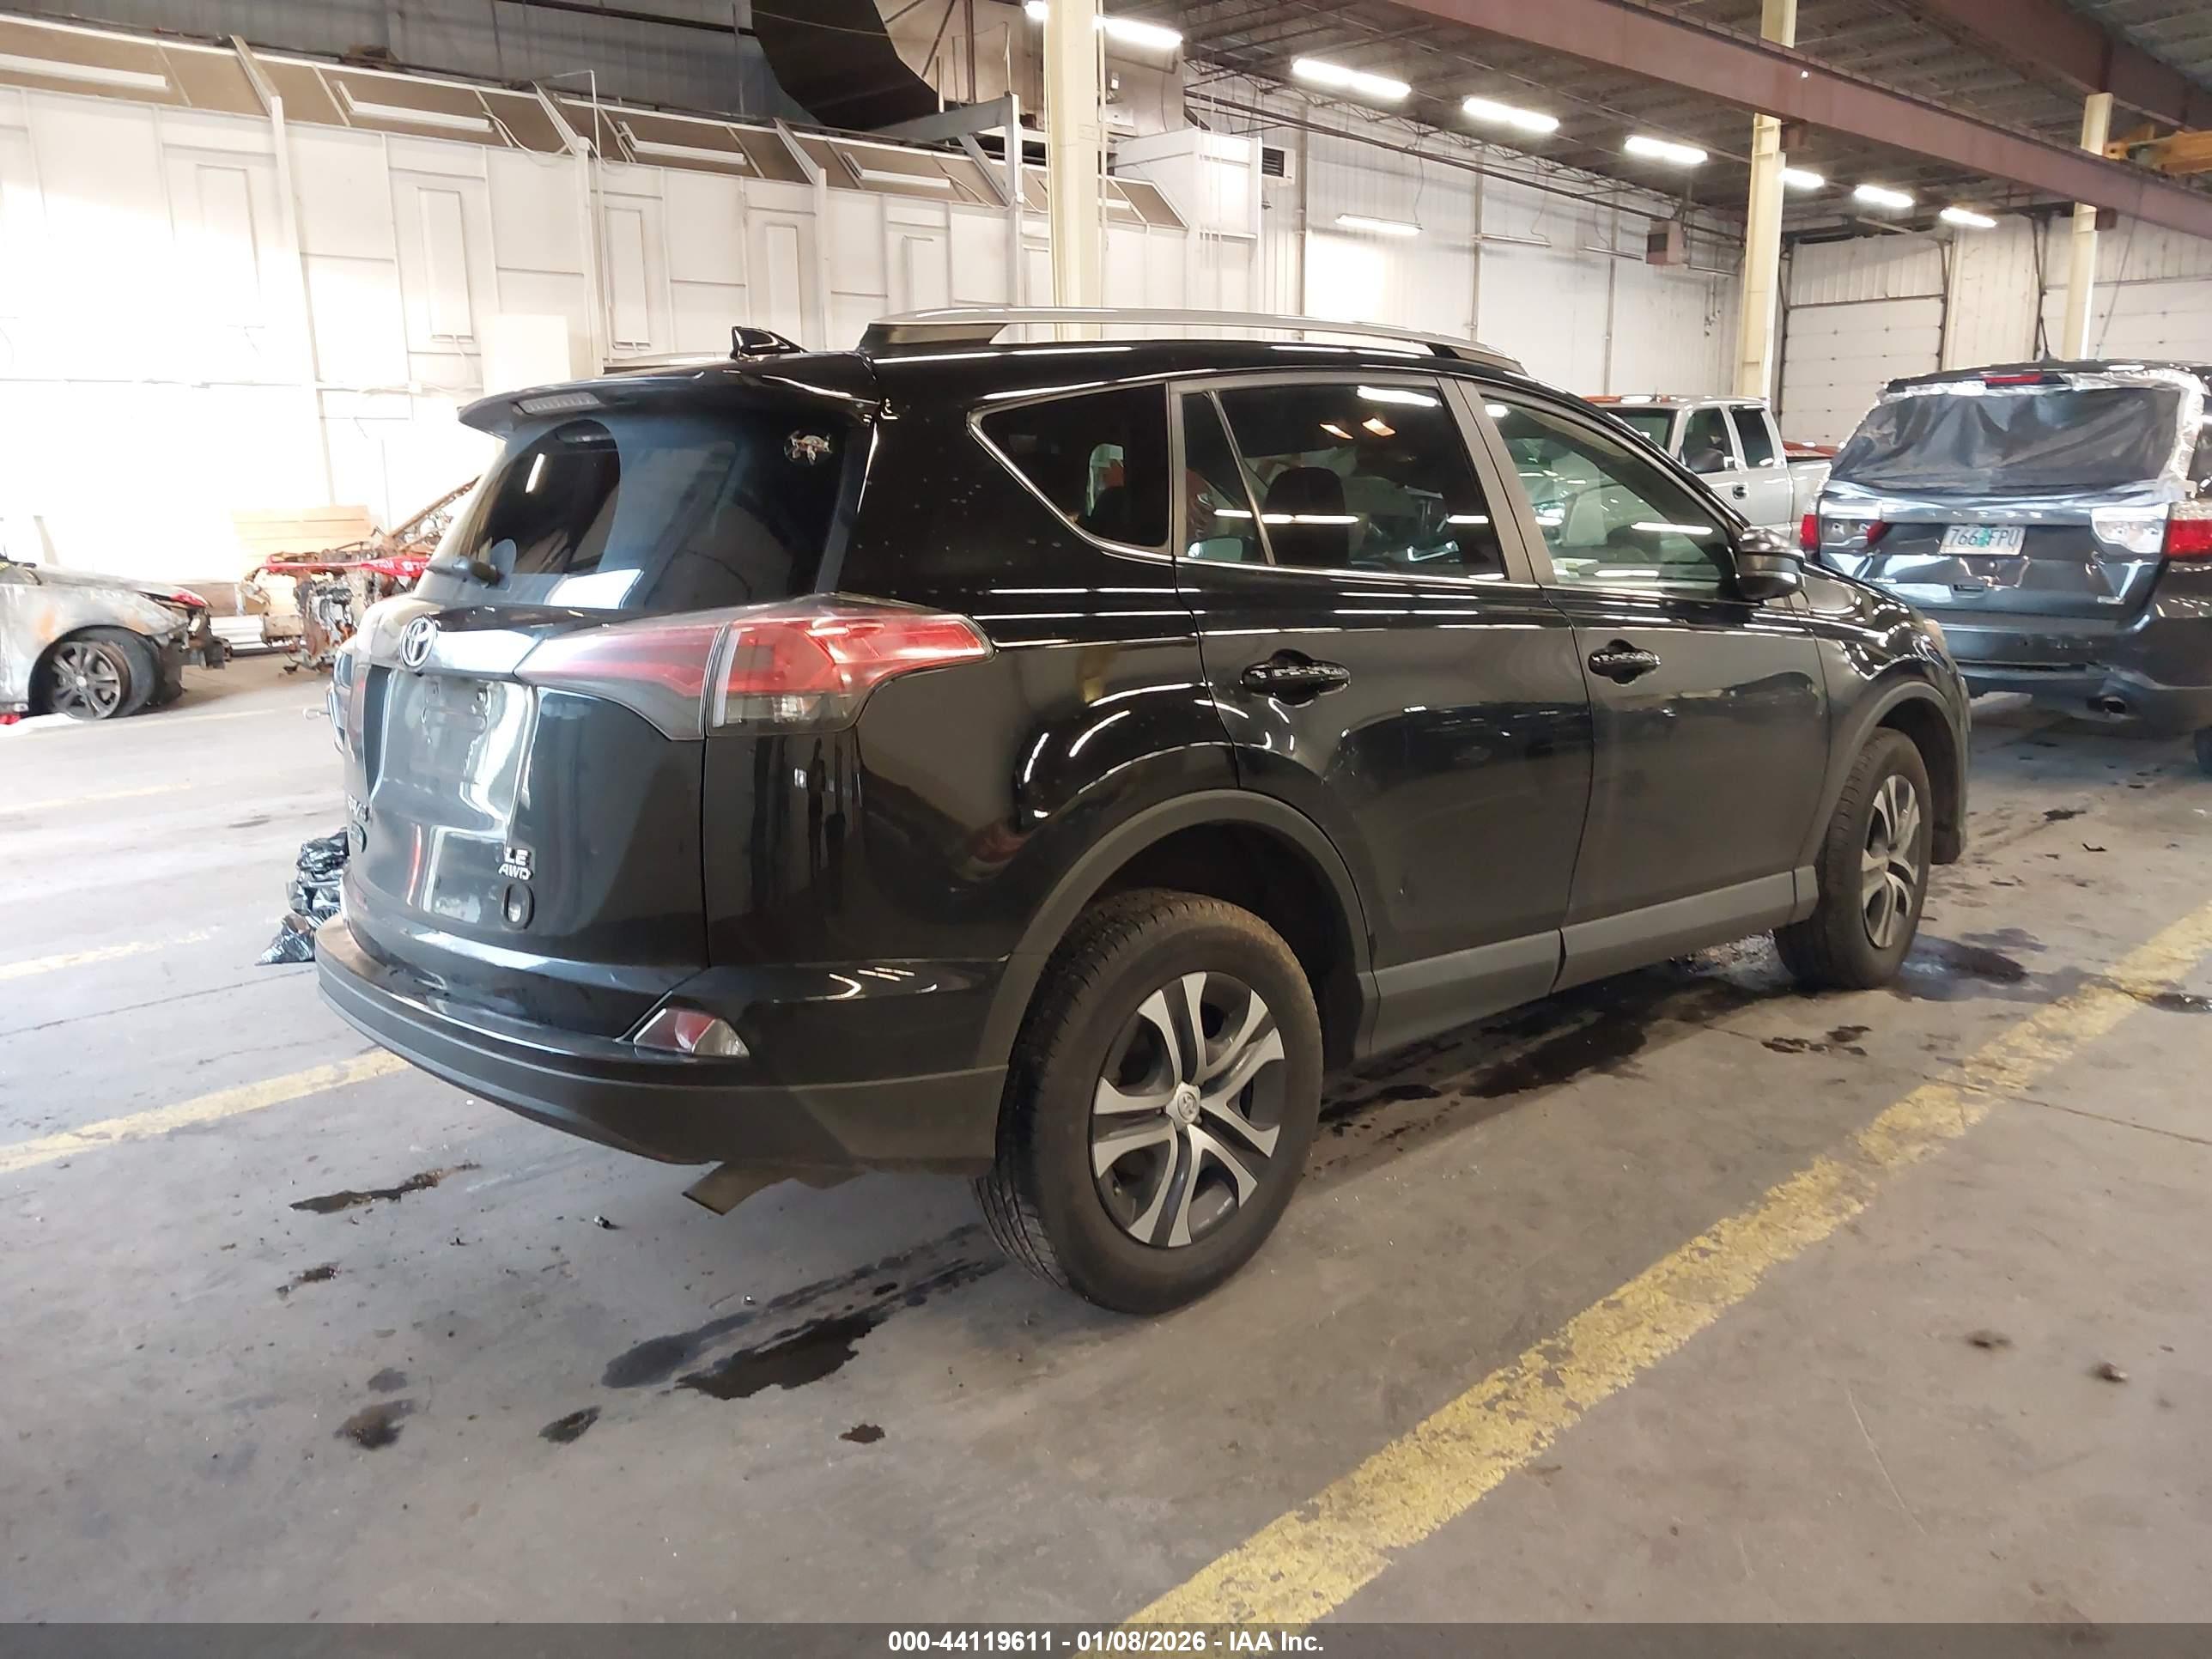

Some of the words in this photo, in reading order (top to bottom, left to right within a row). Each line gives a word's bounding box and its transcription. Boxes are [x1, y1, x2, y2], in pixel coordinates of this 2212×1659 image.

[1950, 528, 1978, 546] 766
[505, 847, 529, 866] LE
[498, 863, 531, 880] AWD
